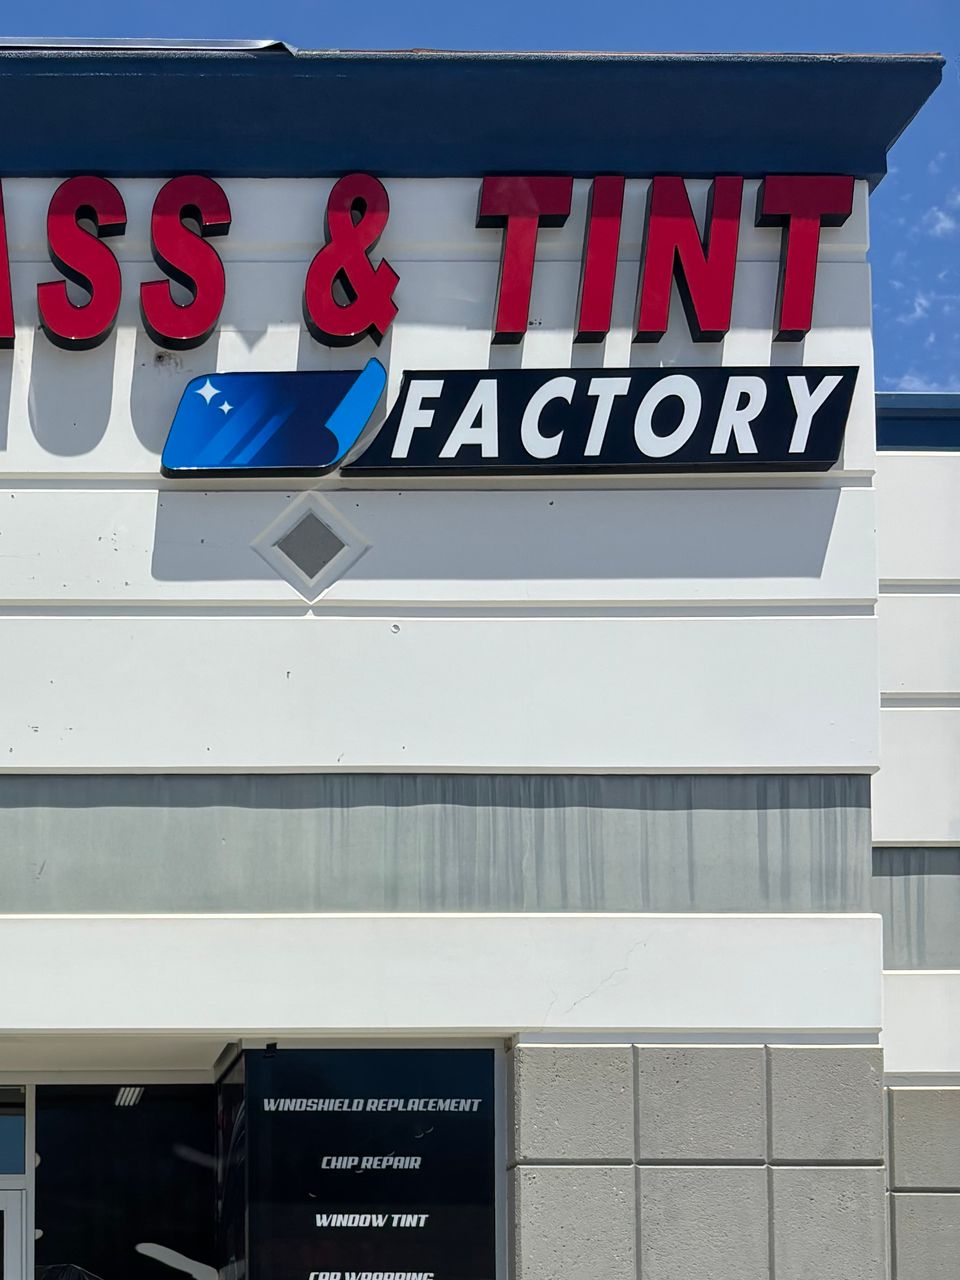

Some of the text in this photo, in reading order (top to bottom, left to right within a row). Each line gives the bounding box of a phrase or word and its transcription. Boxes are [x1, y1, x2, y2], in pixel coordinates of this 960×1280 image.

[302, 172, 401, 347] &
[476, 175, 855, 343] TINT
[390, 372, 843, 460] FACTORY
[263, 1098, 482, 1112] WINDSHIELD REPLACEMENT
[321, 1156, 422, 1170] CHIP REPAIR
[315, 1214, 429, 1228] WINDOW TINT
